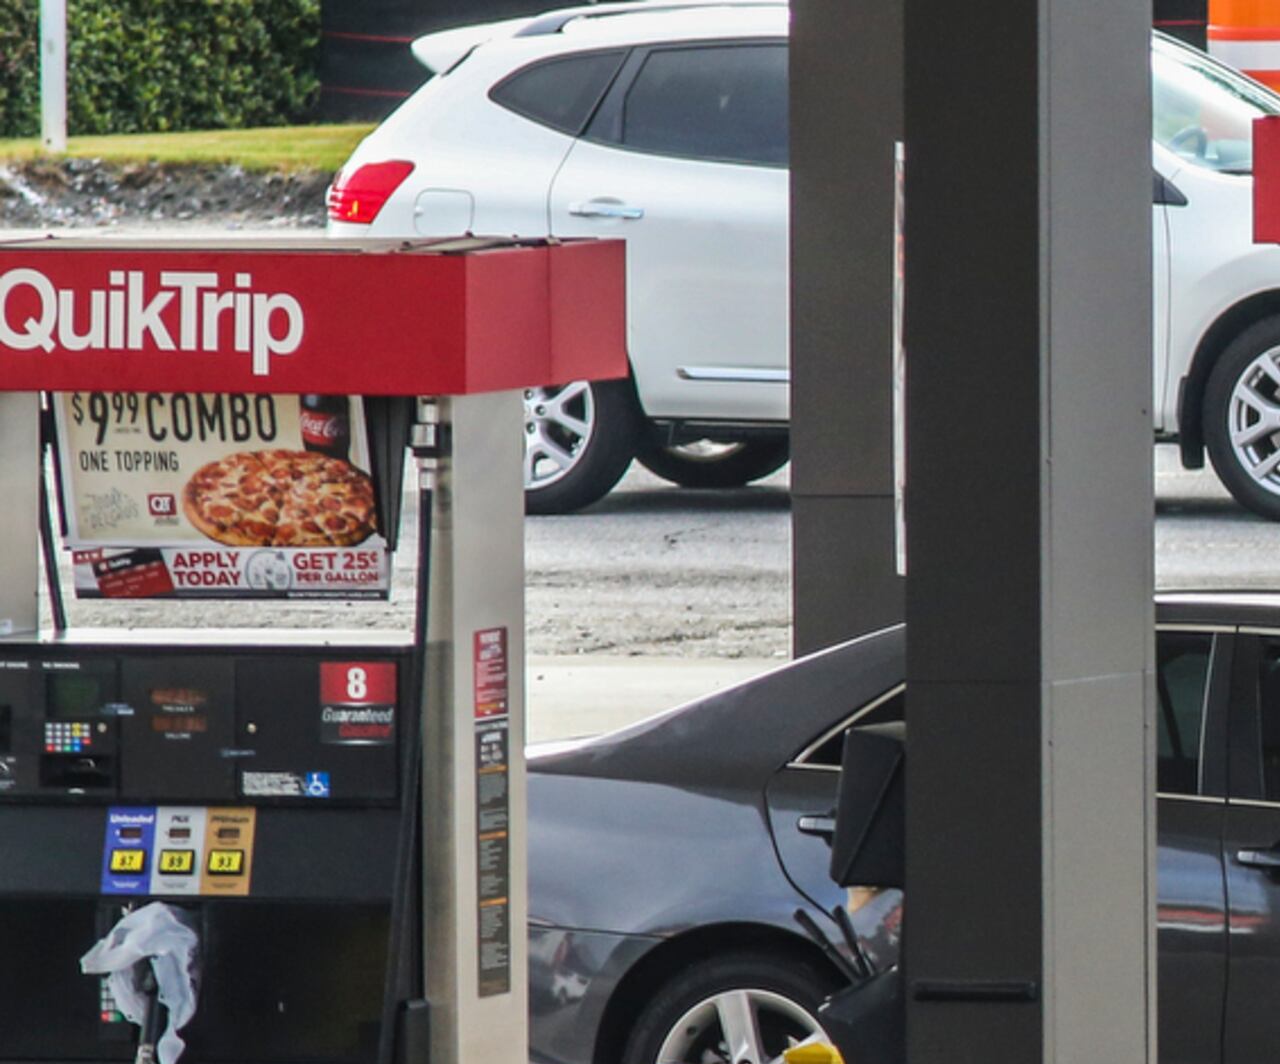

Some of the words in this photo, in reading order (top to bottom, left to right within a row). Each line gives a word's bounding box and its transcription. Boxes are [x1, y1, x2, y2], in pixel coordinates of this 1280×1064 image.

[0, 268, 304, 375] QuikTrip
[146, 391, 278, 442] COMBO
[79, 450, 109, 473] ONE
[117, 450, 179, 473] TOPPING
[151, 494, 173, 513] QT
[173, 552, 239, 568] APPLY
[293, 552, 338, 570] GET
[173, 571, 241, 586] TODAY
[296, 572, 321, 582] PER
[325, 572, 378, 583] GALLON
[347, 667, 367, 699] 8
[322, 707, 394, 723] Guaranteed
